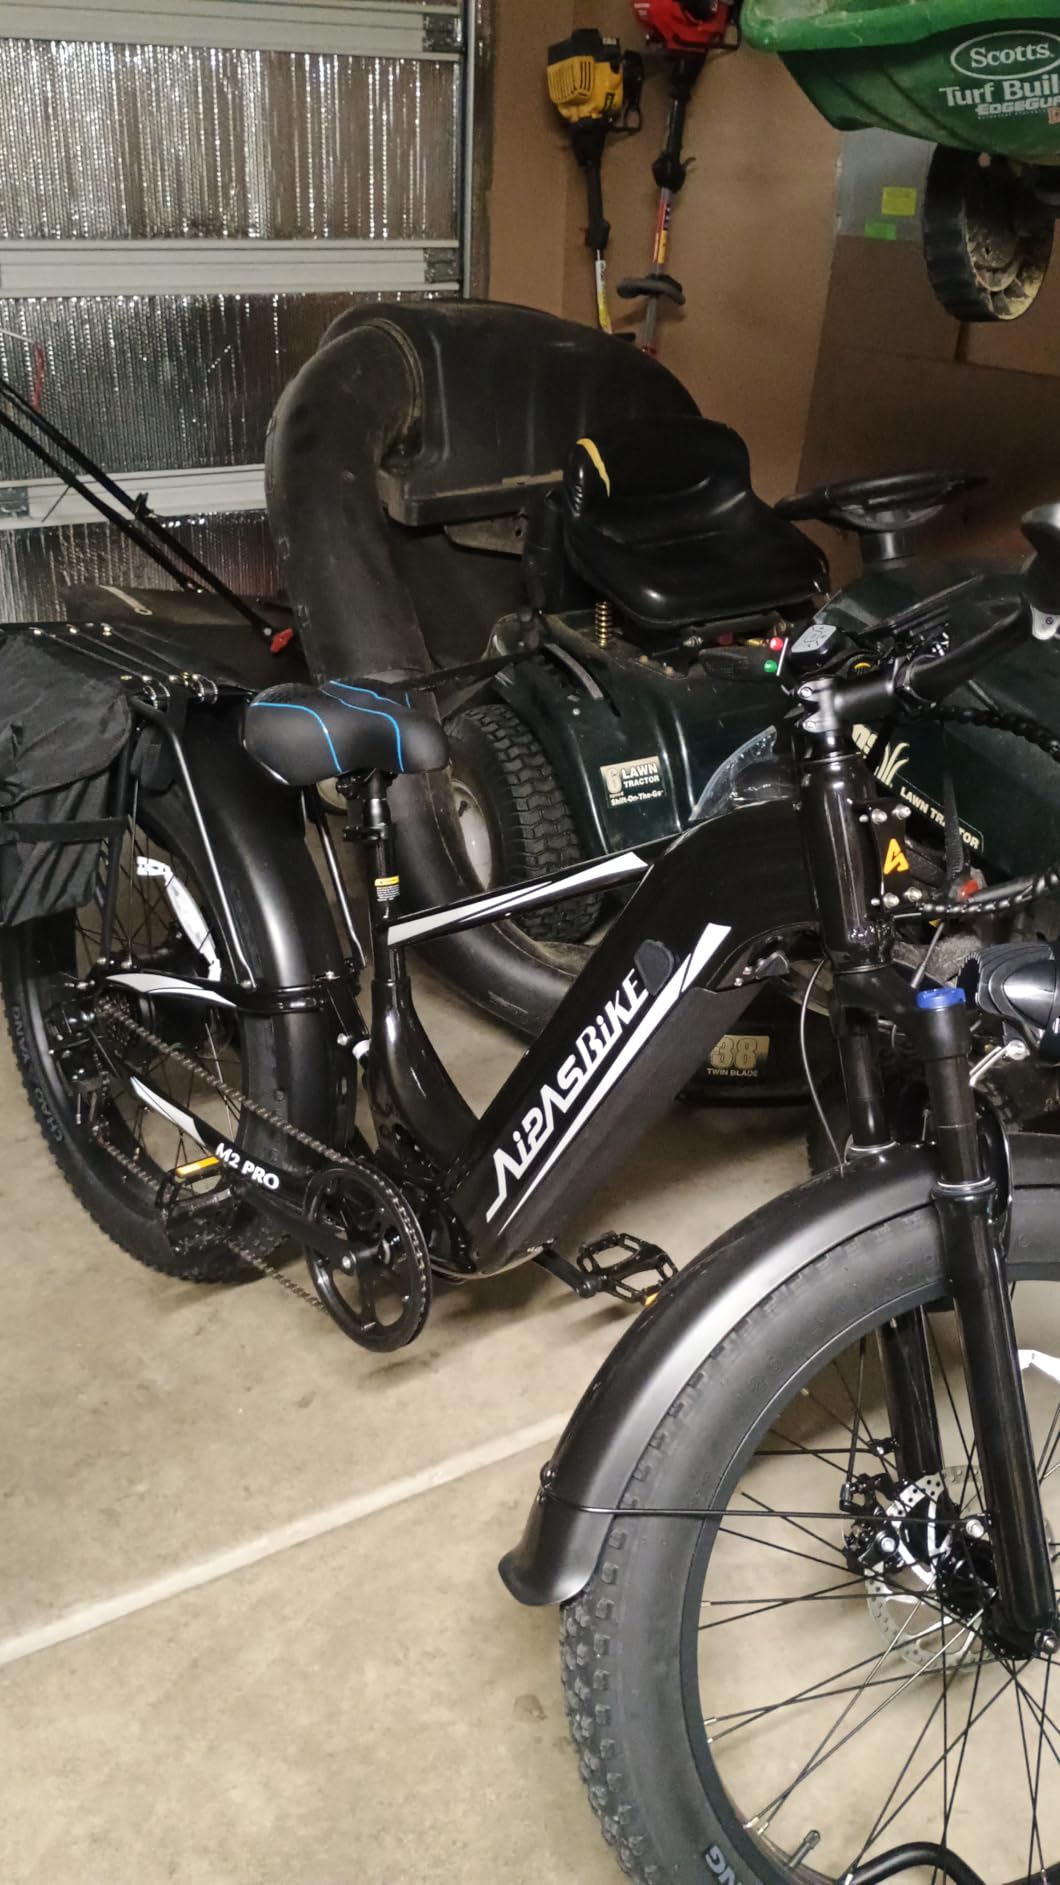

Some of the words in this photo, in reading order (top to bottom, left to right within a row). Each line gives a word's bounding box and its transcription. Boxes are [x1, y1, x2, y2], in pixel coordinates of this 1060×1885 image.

[970, 43, 1051, 68] Scotts
[938, 82, 995, 107] Turf
[621, 763, 658, 779] LAWN
[623, 775, 660, 789] TRACTOR
[900, 786, 929, 814] LAWN
[710, 1037, 756, 1069] 38
[706, 1068, 729, 1076] TWIN
[730, 1069, 759, 1077] BLADE
[216, 1142, 241, 1169] M2
[241, 1160, 280, 1190] PRO
